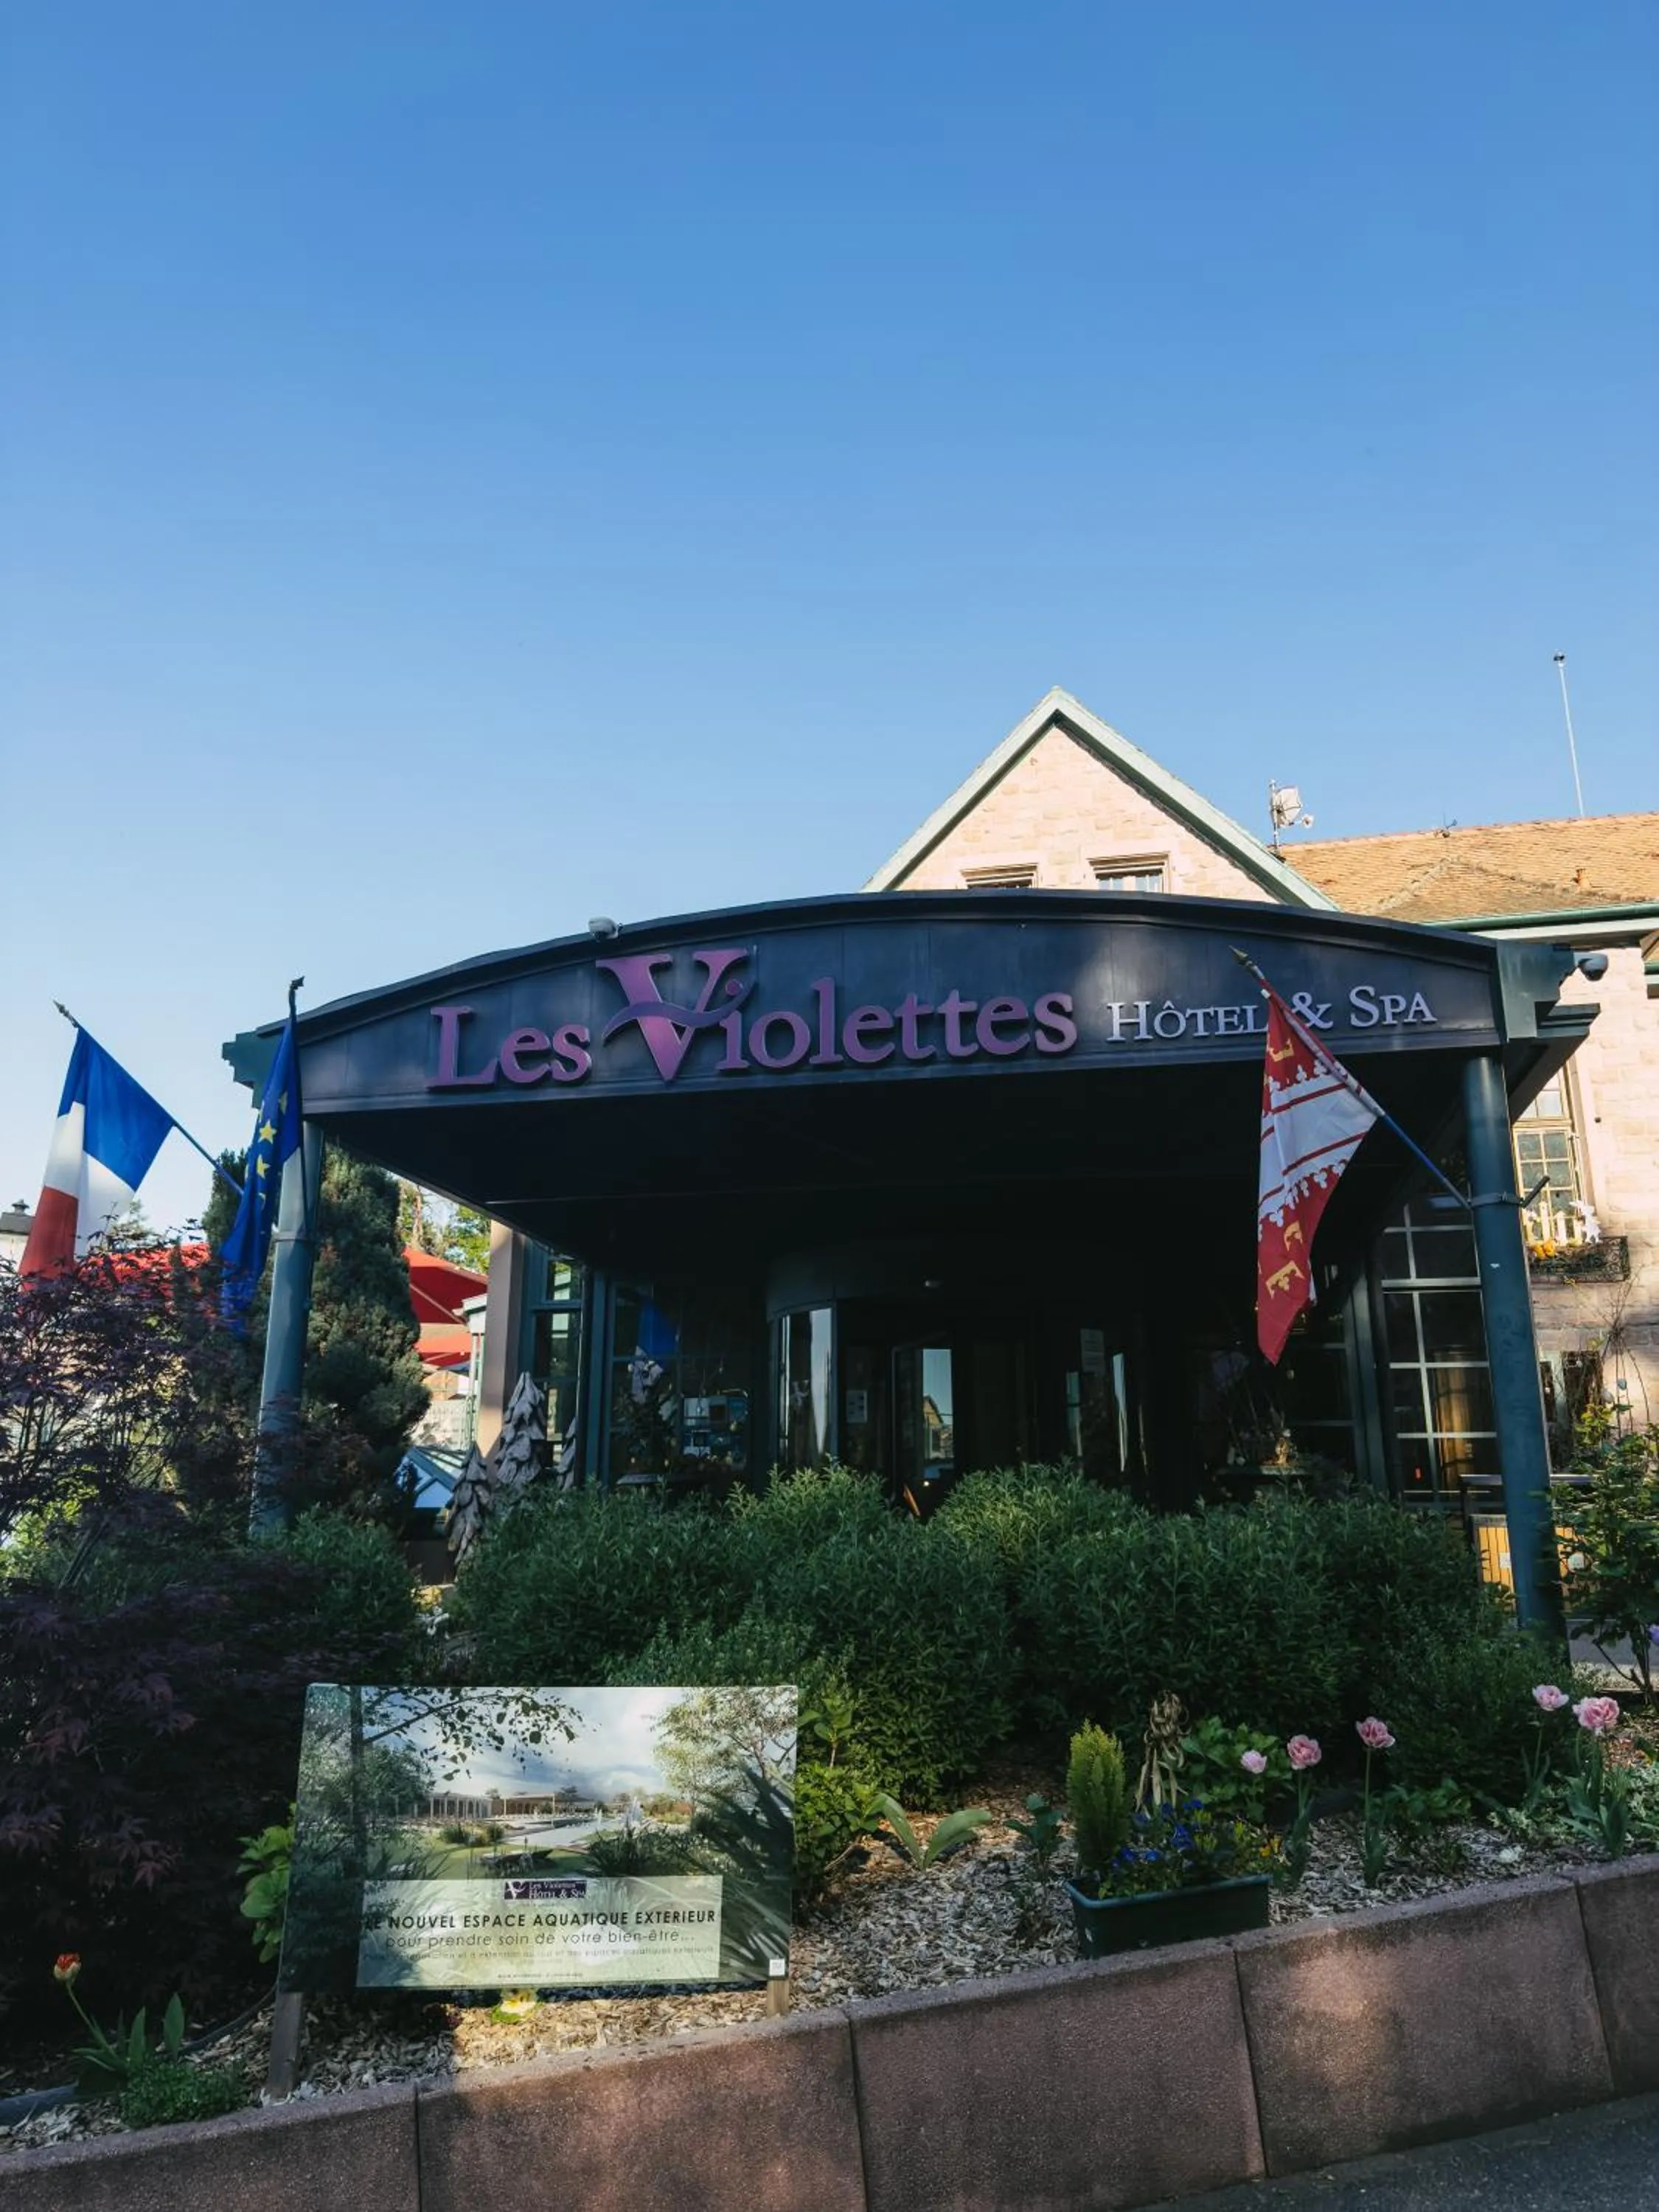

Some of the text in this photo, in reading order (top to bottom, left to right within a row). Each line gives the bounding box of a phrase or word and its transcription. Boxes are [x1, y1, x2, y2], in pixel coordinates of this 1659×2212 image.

[425, 948, 1079, 1086] Les Violettes
[1291, 992, 1333, 1029] &
[1349, 985, 1437, 1026] SPA
[389, 1916, 456, 1930] NOUVEL
[464, 1915, 525, 1927] ESPACE
[533, 1913, 628, 1927] AQUATIQUE
[635, 1910, 715, 1924] EXTERIEUR
[386, 1936, 421, 1948] pour
[428, 1934, 493, 1948] prendre
[498, 1933, 529, 1945] soin
[535, 1931, 555, 1944] de
[563, 1931, 602, 1944] votre
